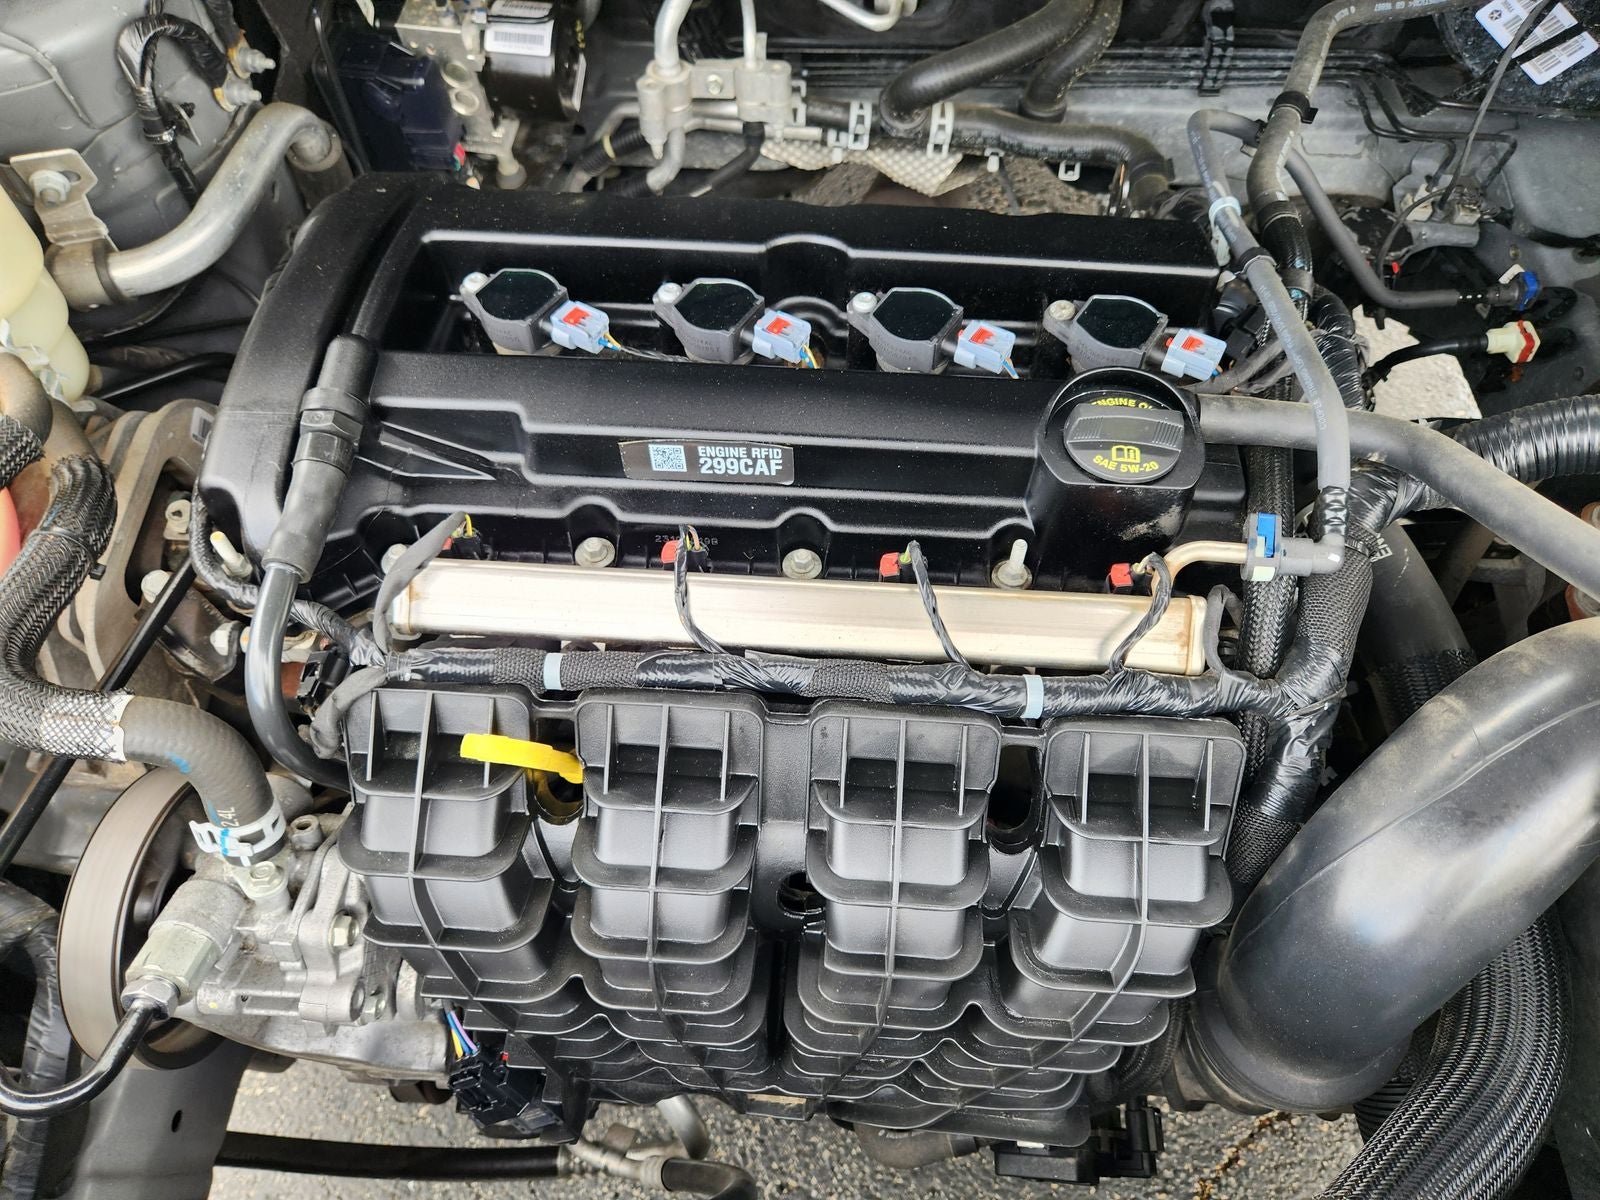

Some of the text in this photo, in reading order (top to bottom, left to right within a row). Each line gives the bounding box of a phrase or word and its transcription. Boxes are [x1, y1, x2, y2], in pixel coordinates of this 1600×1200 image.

[697, 446, 782, 459] ENGINE RFID
[699, 457, 783, 476] 299CAF
[1092, 454, 1159, 473] SAE 5W-20
[216, 806, 240, 827] 2.4L
